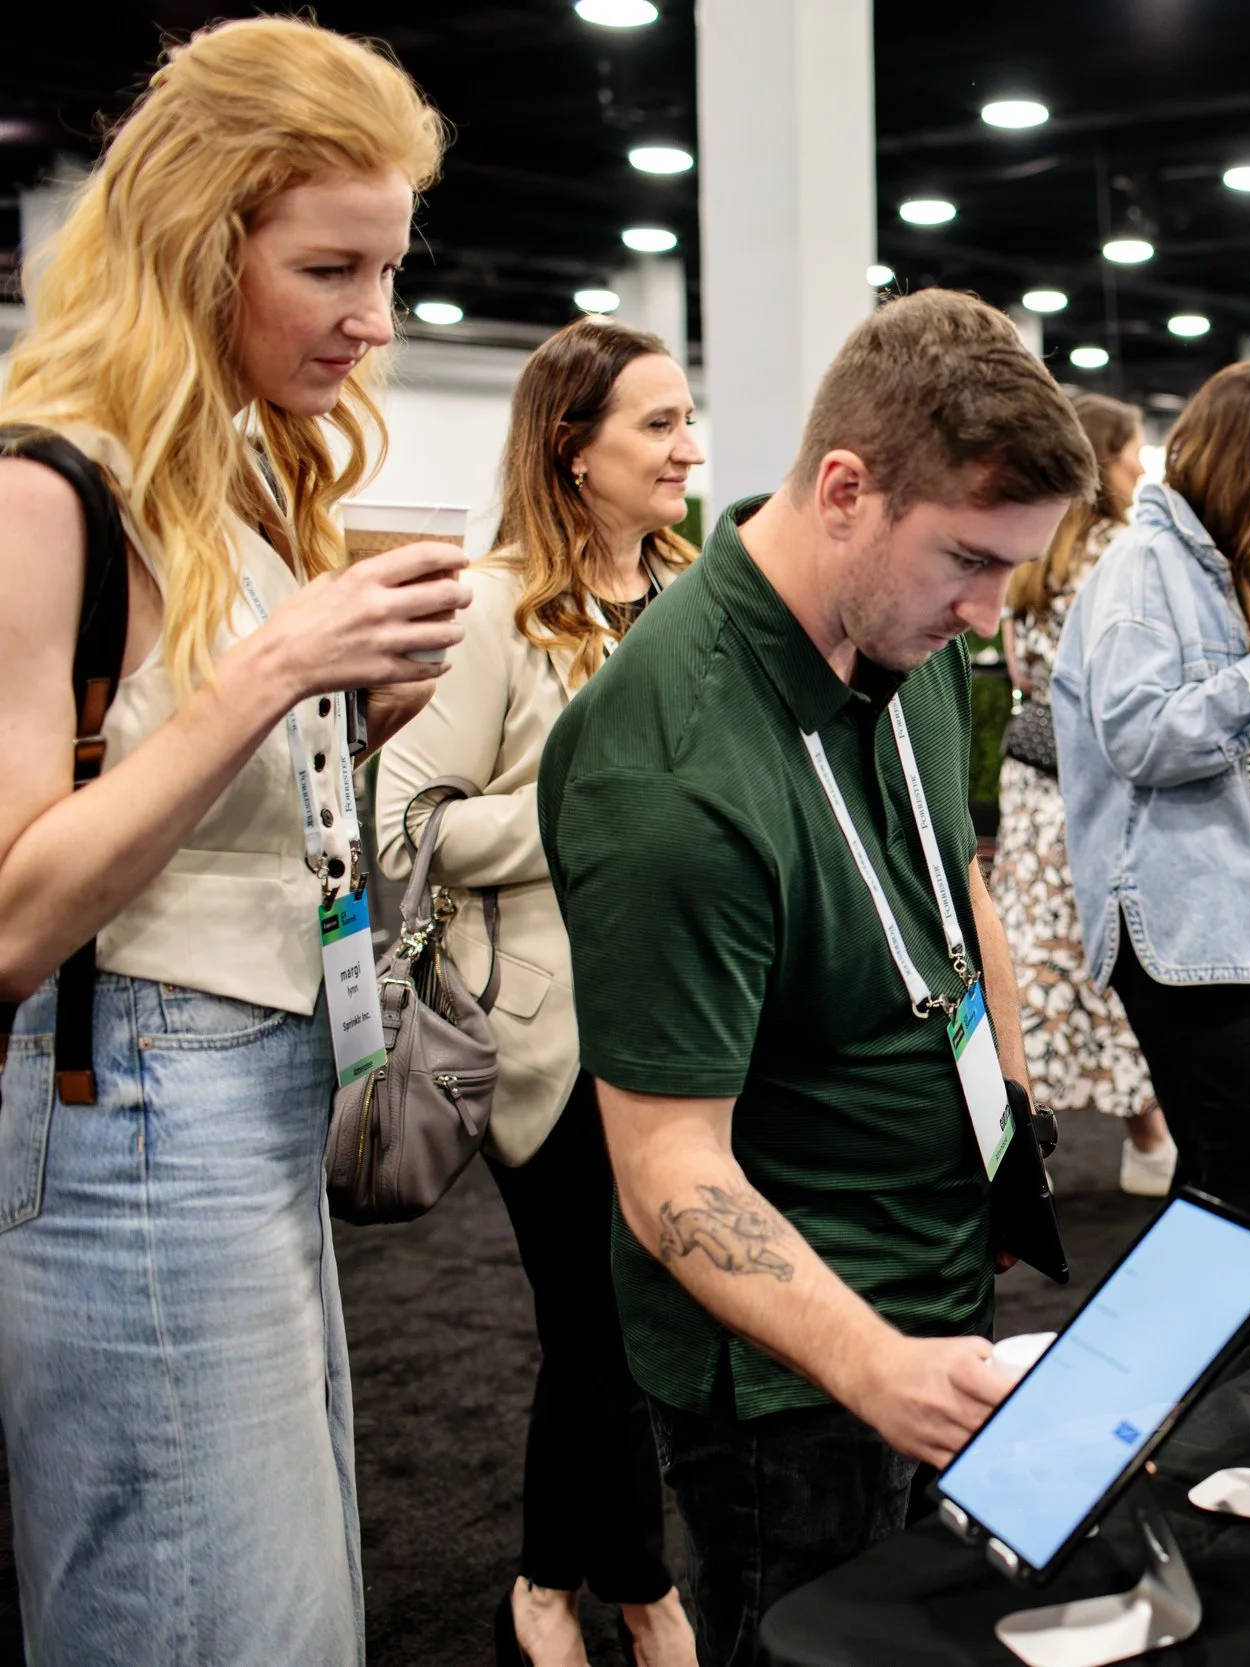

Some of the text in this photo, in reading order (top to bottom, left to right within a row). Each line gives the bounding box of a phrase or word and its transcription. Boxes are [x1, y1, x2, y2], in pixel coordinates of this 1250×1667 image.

[298, 769, 314, 828] FORRESTER
[341, 756, 353, 812] FORRESTER
[910, 774, 928, 831] FORRESTER
[933, 864, 952, 919] FORRESTER
[340, 961, 361, 981] margi
